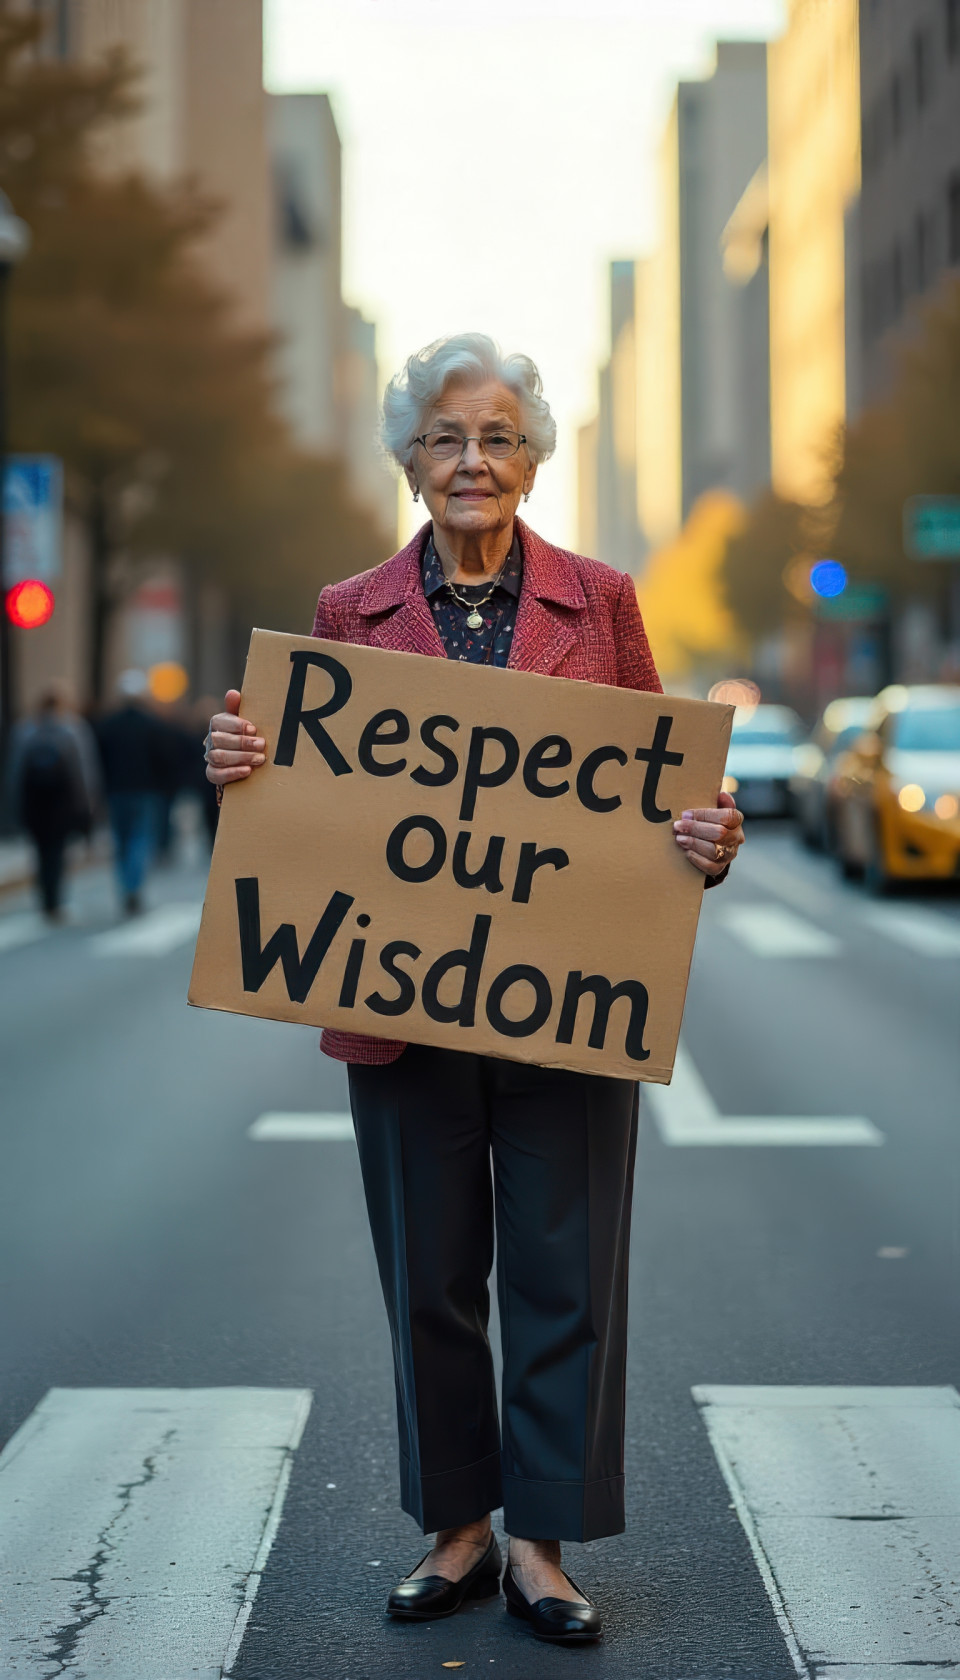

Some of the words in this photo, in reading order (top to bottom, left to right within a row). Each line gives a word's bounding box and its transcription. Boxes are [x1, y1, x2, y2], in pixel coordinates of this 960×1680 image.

[273, 651, 685, 824] Respect
[386, 814, 570, 904] our
[234, 876, 651, 1062] Wisdom
